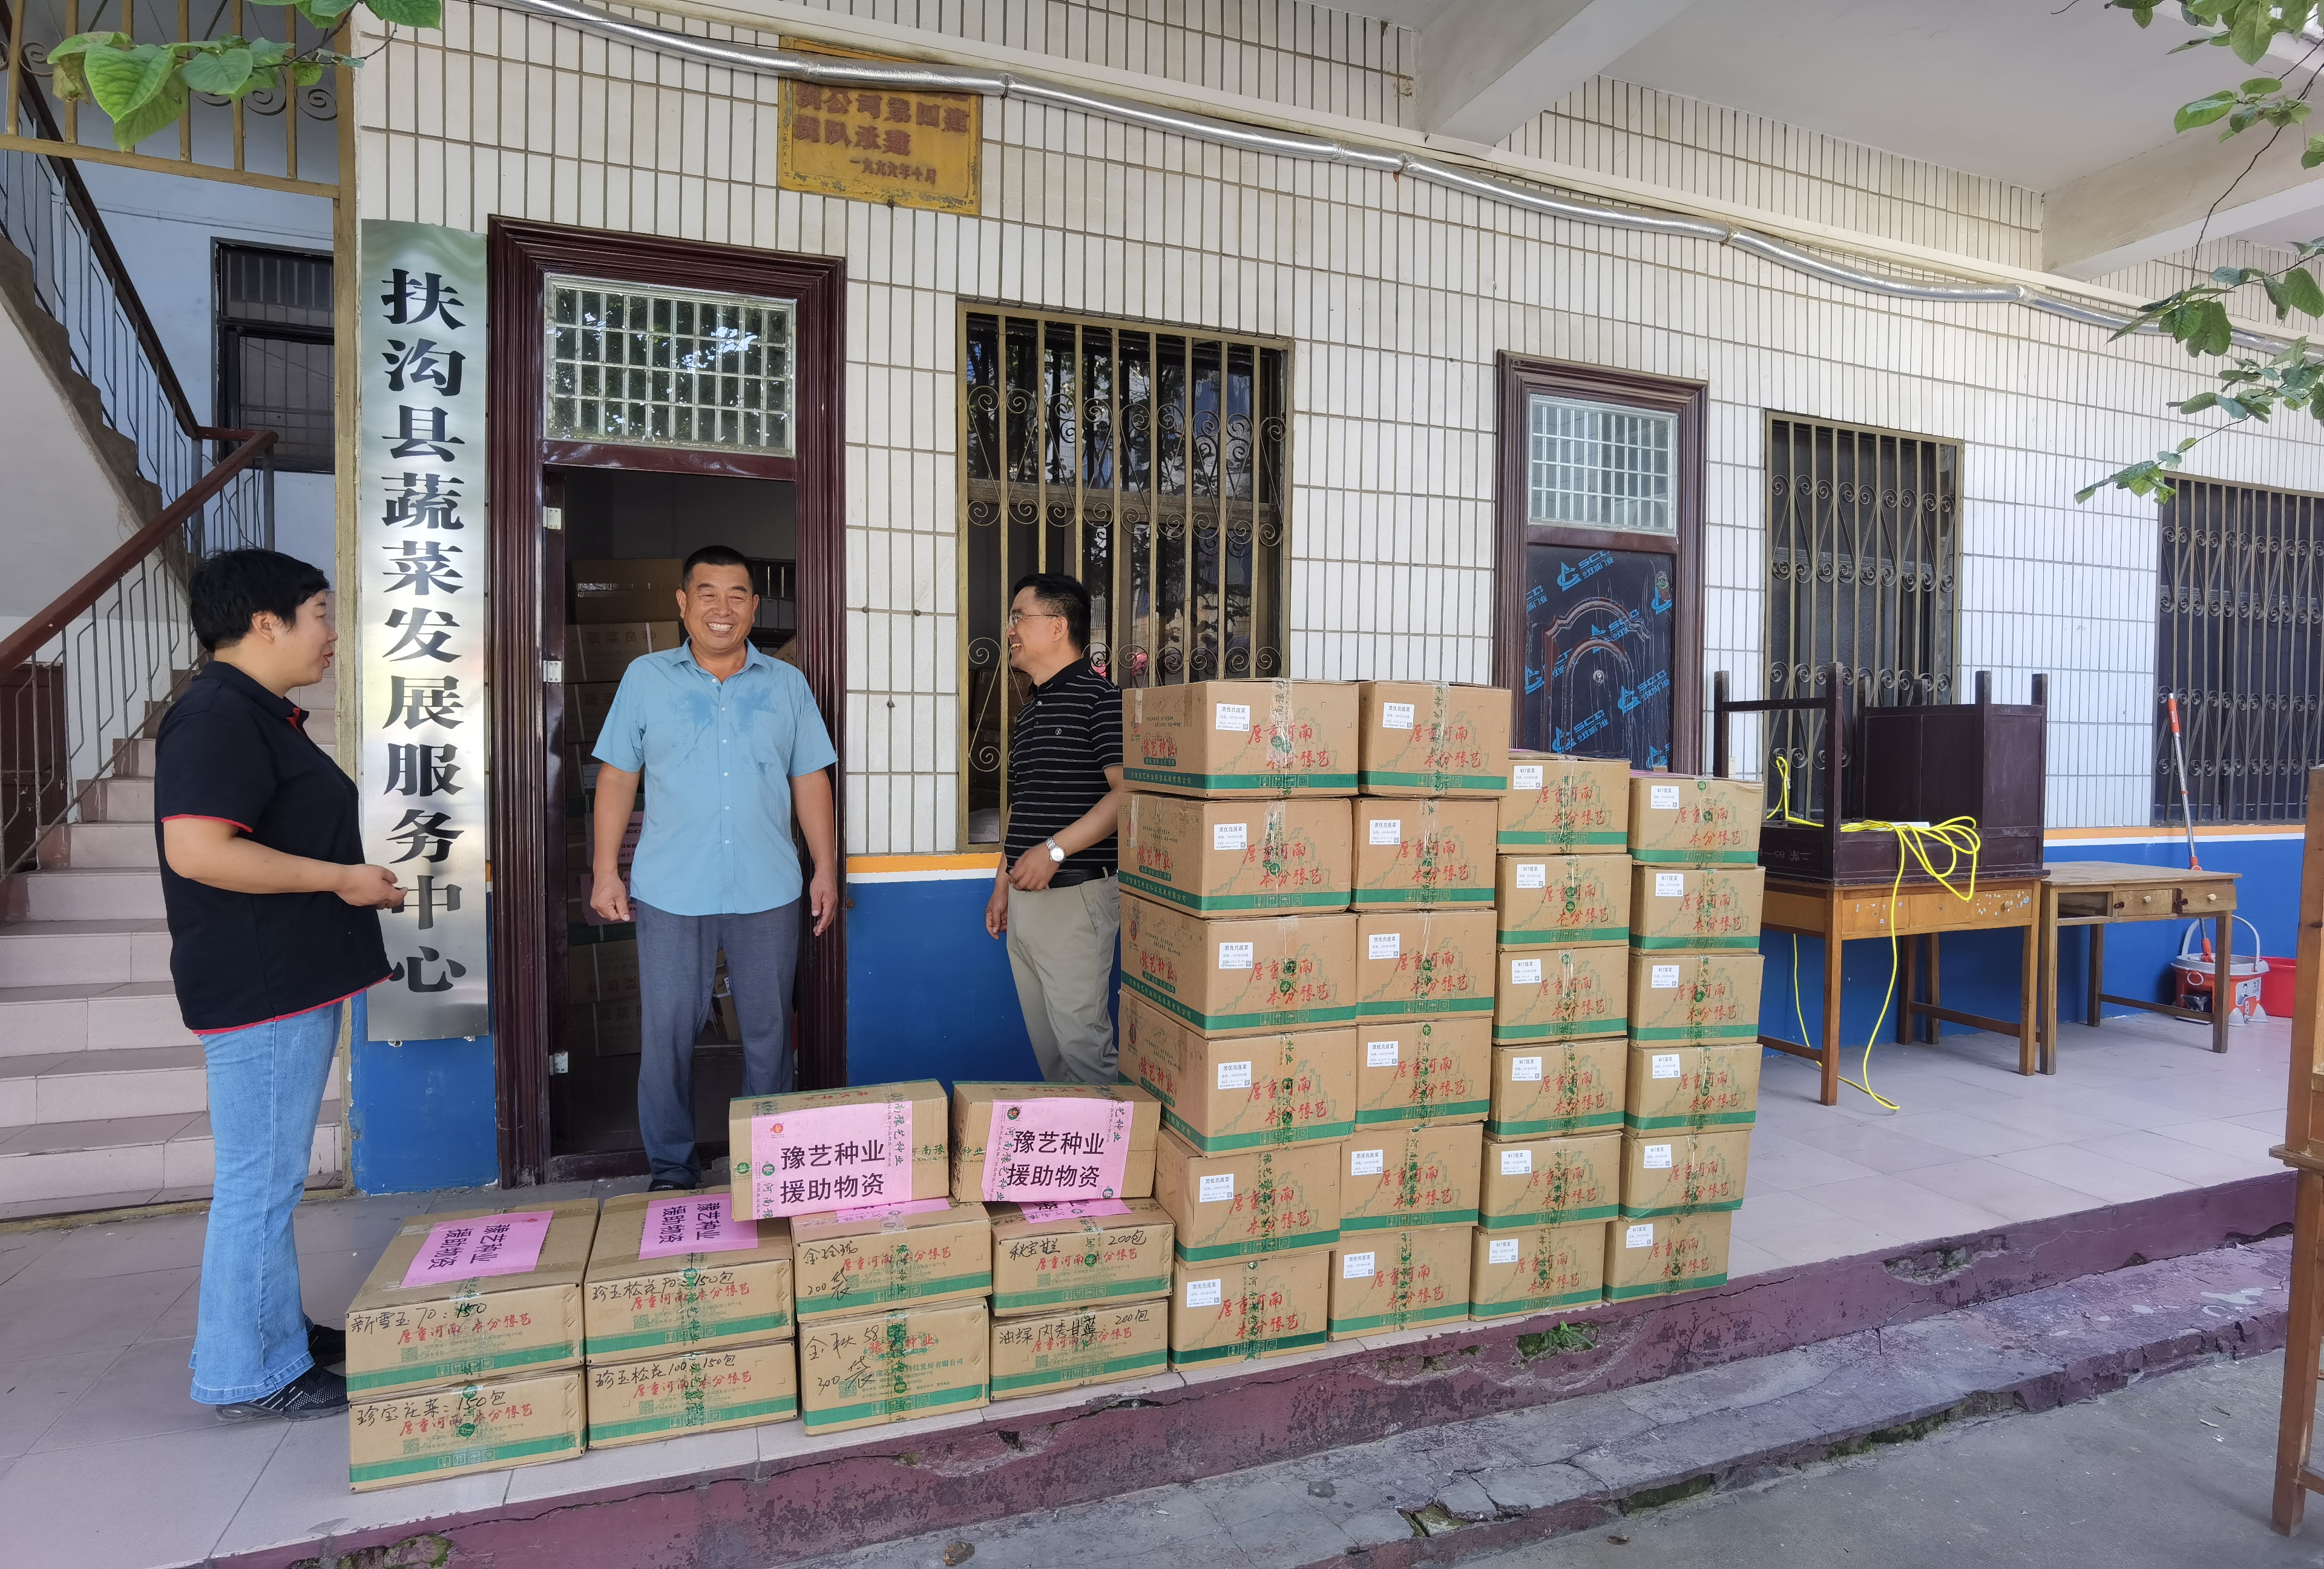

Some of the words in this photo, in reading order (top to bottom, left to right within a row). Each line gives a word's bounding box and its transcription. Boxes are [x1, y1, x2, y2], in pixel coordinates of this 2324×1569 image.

[381, 268, 467, 995] 扶沟县蔬菜发展服务中心
[780, 1139, 885, 1170] 豫艺种业
[1012, 1131, 1104, 1155] 豫艺种业
[780, 1173, 884, 1205] 援助物资
[1007, 1163, 1100, 1188] 援助物资
[658, 1205, 687, 1244] 援助物资
[695, 1202, 721, 1240] 豫艺种业
[427, 1228, 471, 1270] 援助物资
[470, 1223, 510, 1265] 豫艺种业
[1036, 1254, 1084, 1272] 厚重河南
[398, 1324, 461, 1345] 厚重河南
[472, 1313, 531, 1333] 本分豫艺
[869, 1333, 935, 1355] 豫种业
[400, 1414, 462, 1436] 厚重河南
[474, 1404, 533, 1425] 本分豫艺
